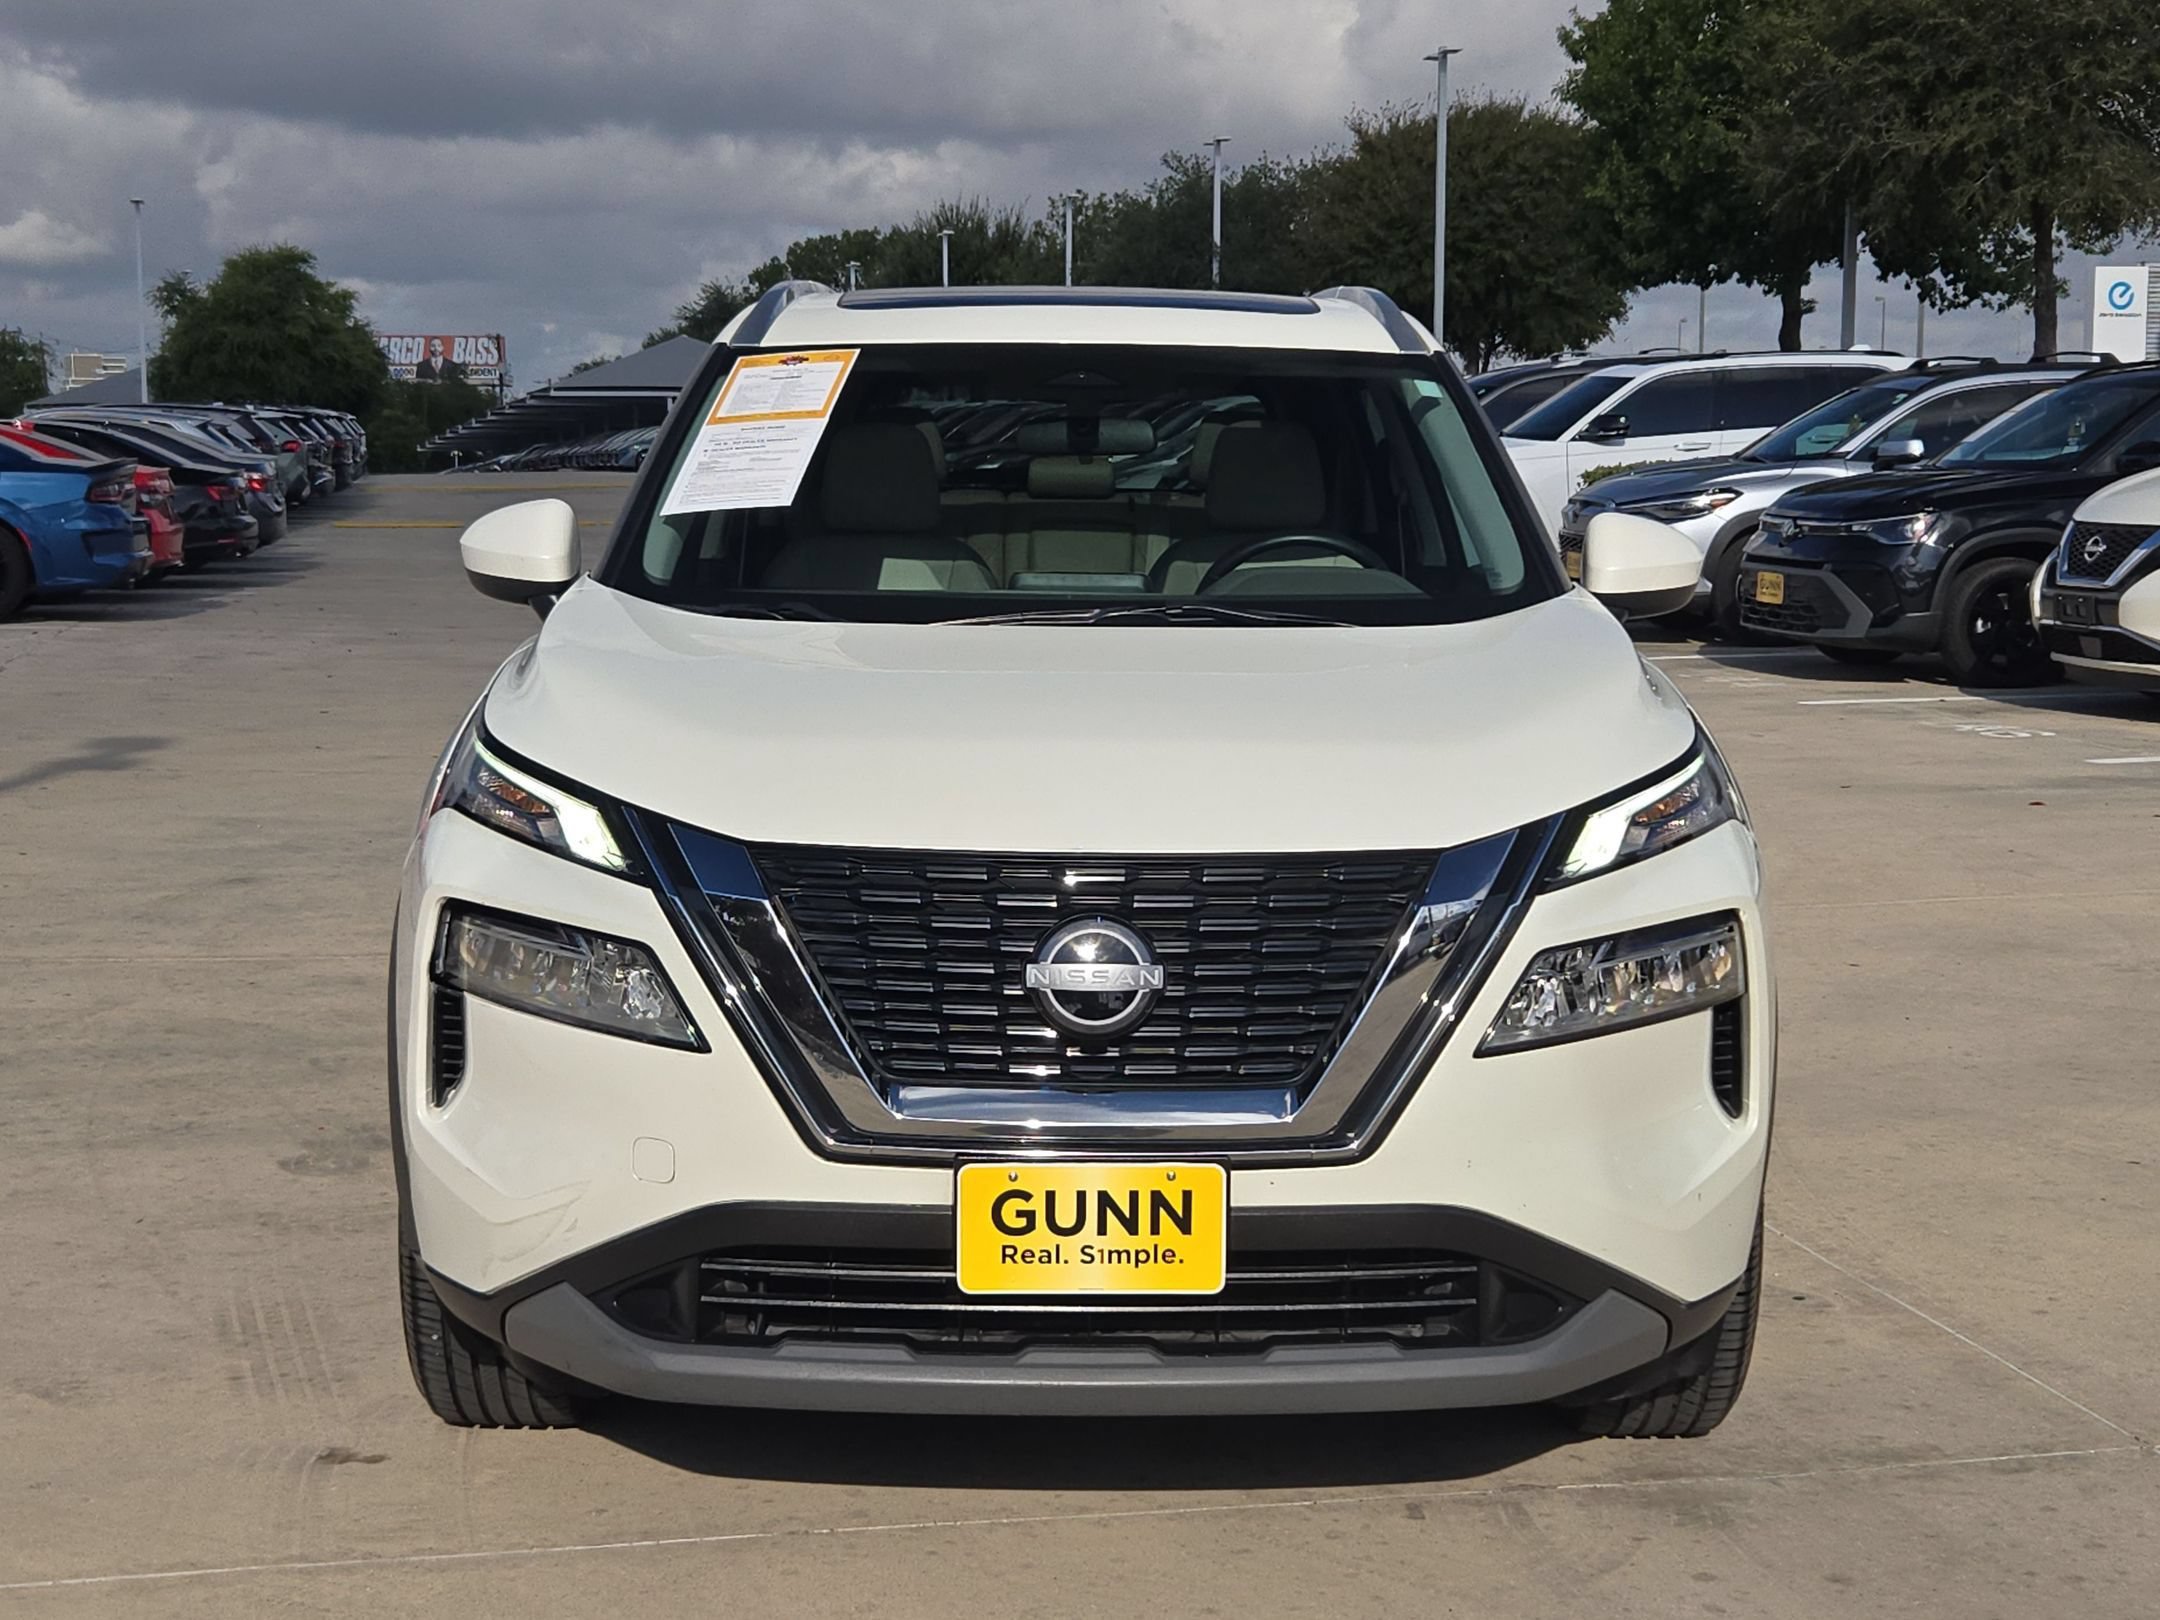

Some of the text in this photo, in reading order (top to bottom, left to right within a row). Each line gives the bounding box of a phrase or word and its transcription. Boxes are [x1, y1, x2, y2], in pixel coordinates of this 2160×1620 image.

[375, 336, 499, 365] ARCO BASS
[1031, 968, 1158, 986] NISSAN
[991, 1189, 1193, 1237] GUNN
[1001, 1244, 1068, 1264] Real.
